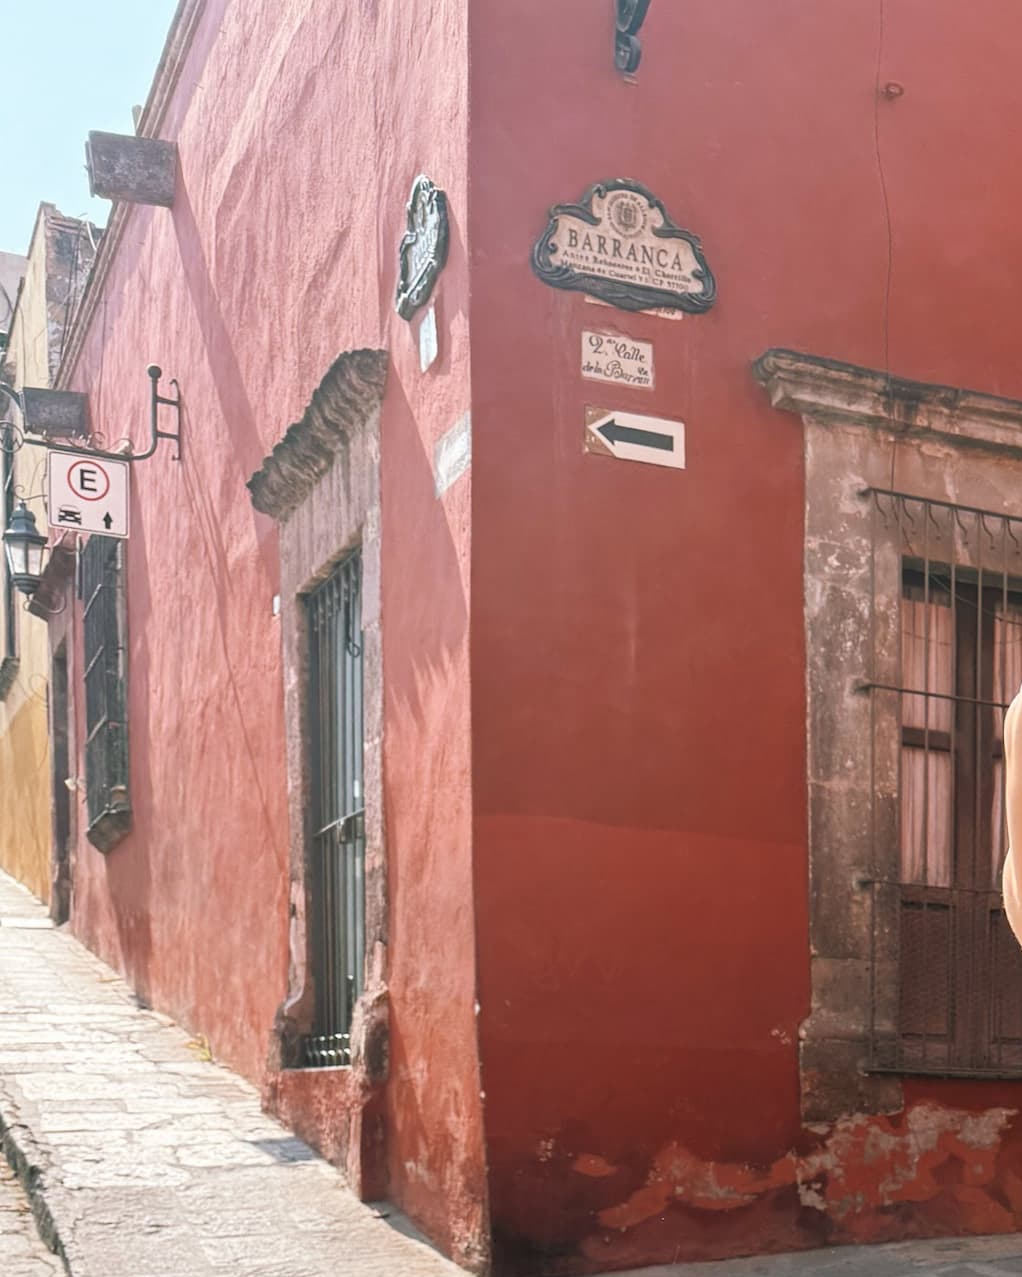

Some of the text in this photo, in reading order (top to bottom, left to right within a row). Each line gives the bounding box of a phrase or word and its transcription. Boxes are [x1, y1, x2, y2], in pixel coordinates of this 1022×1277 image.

[567, 228, 683, 271] BARRANCA
[615, 343, 646, 363] Calle
[79, 468, 97, 492] E
